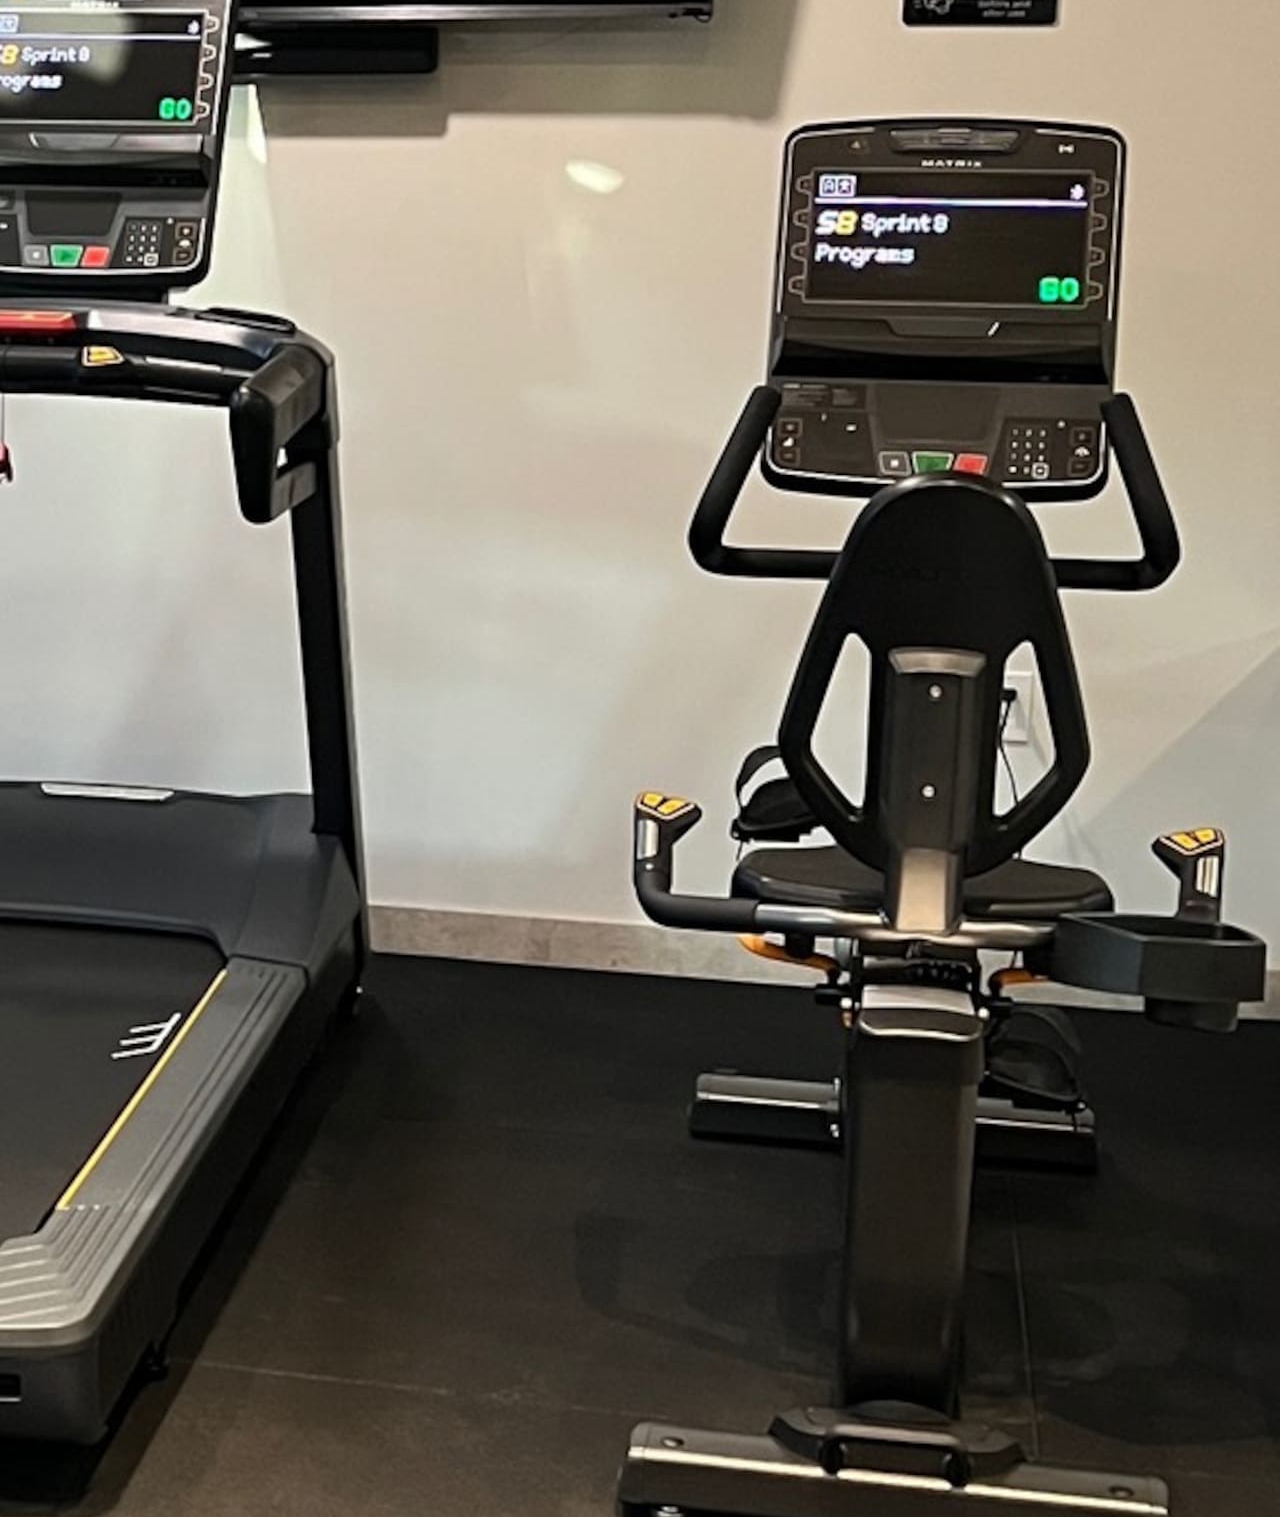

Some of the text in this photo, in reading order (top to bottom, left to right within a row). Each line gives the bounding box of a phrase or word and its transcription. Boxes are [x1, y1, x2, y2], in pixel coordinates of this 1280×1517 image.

[22, 46, 76, 66] Sprint
[814, 210, 858, 235] S8
[862, 213, 931, 237] Sprint
[814, 243, 915, 268] Programs
